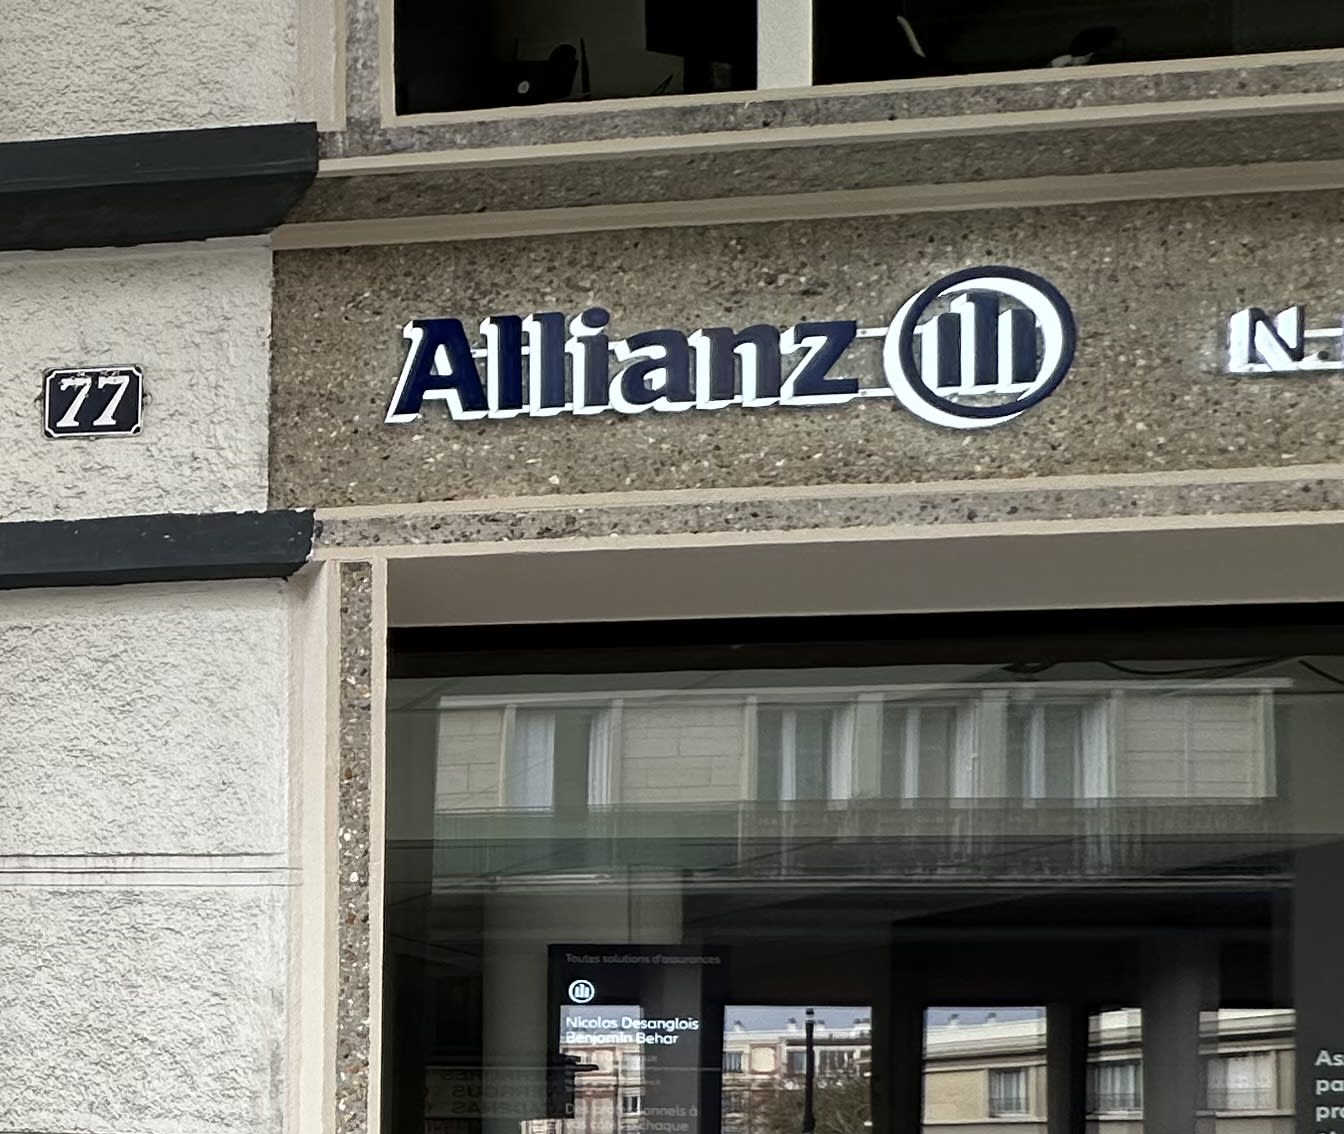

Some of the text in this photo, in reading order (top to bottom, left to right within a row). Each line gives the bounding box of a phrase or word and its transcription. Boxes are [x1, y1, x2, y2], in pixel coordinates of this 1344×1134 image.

[386, 307, 860, 422] Allianz
[56, 374, 130, 427] 77
[565, 1031, 679, 1046] Benjamin Behar
[566, 1016, 699, 1032] Nicolas Desanglois
